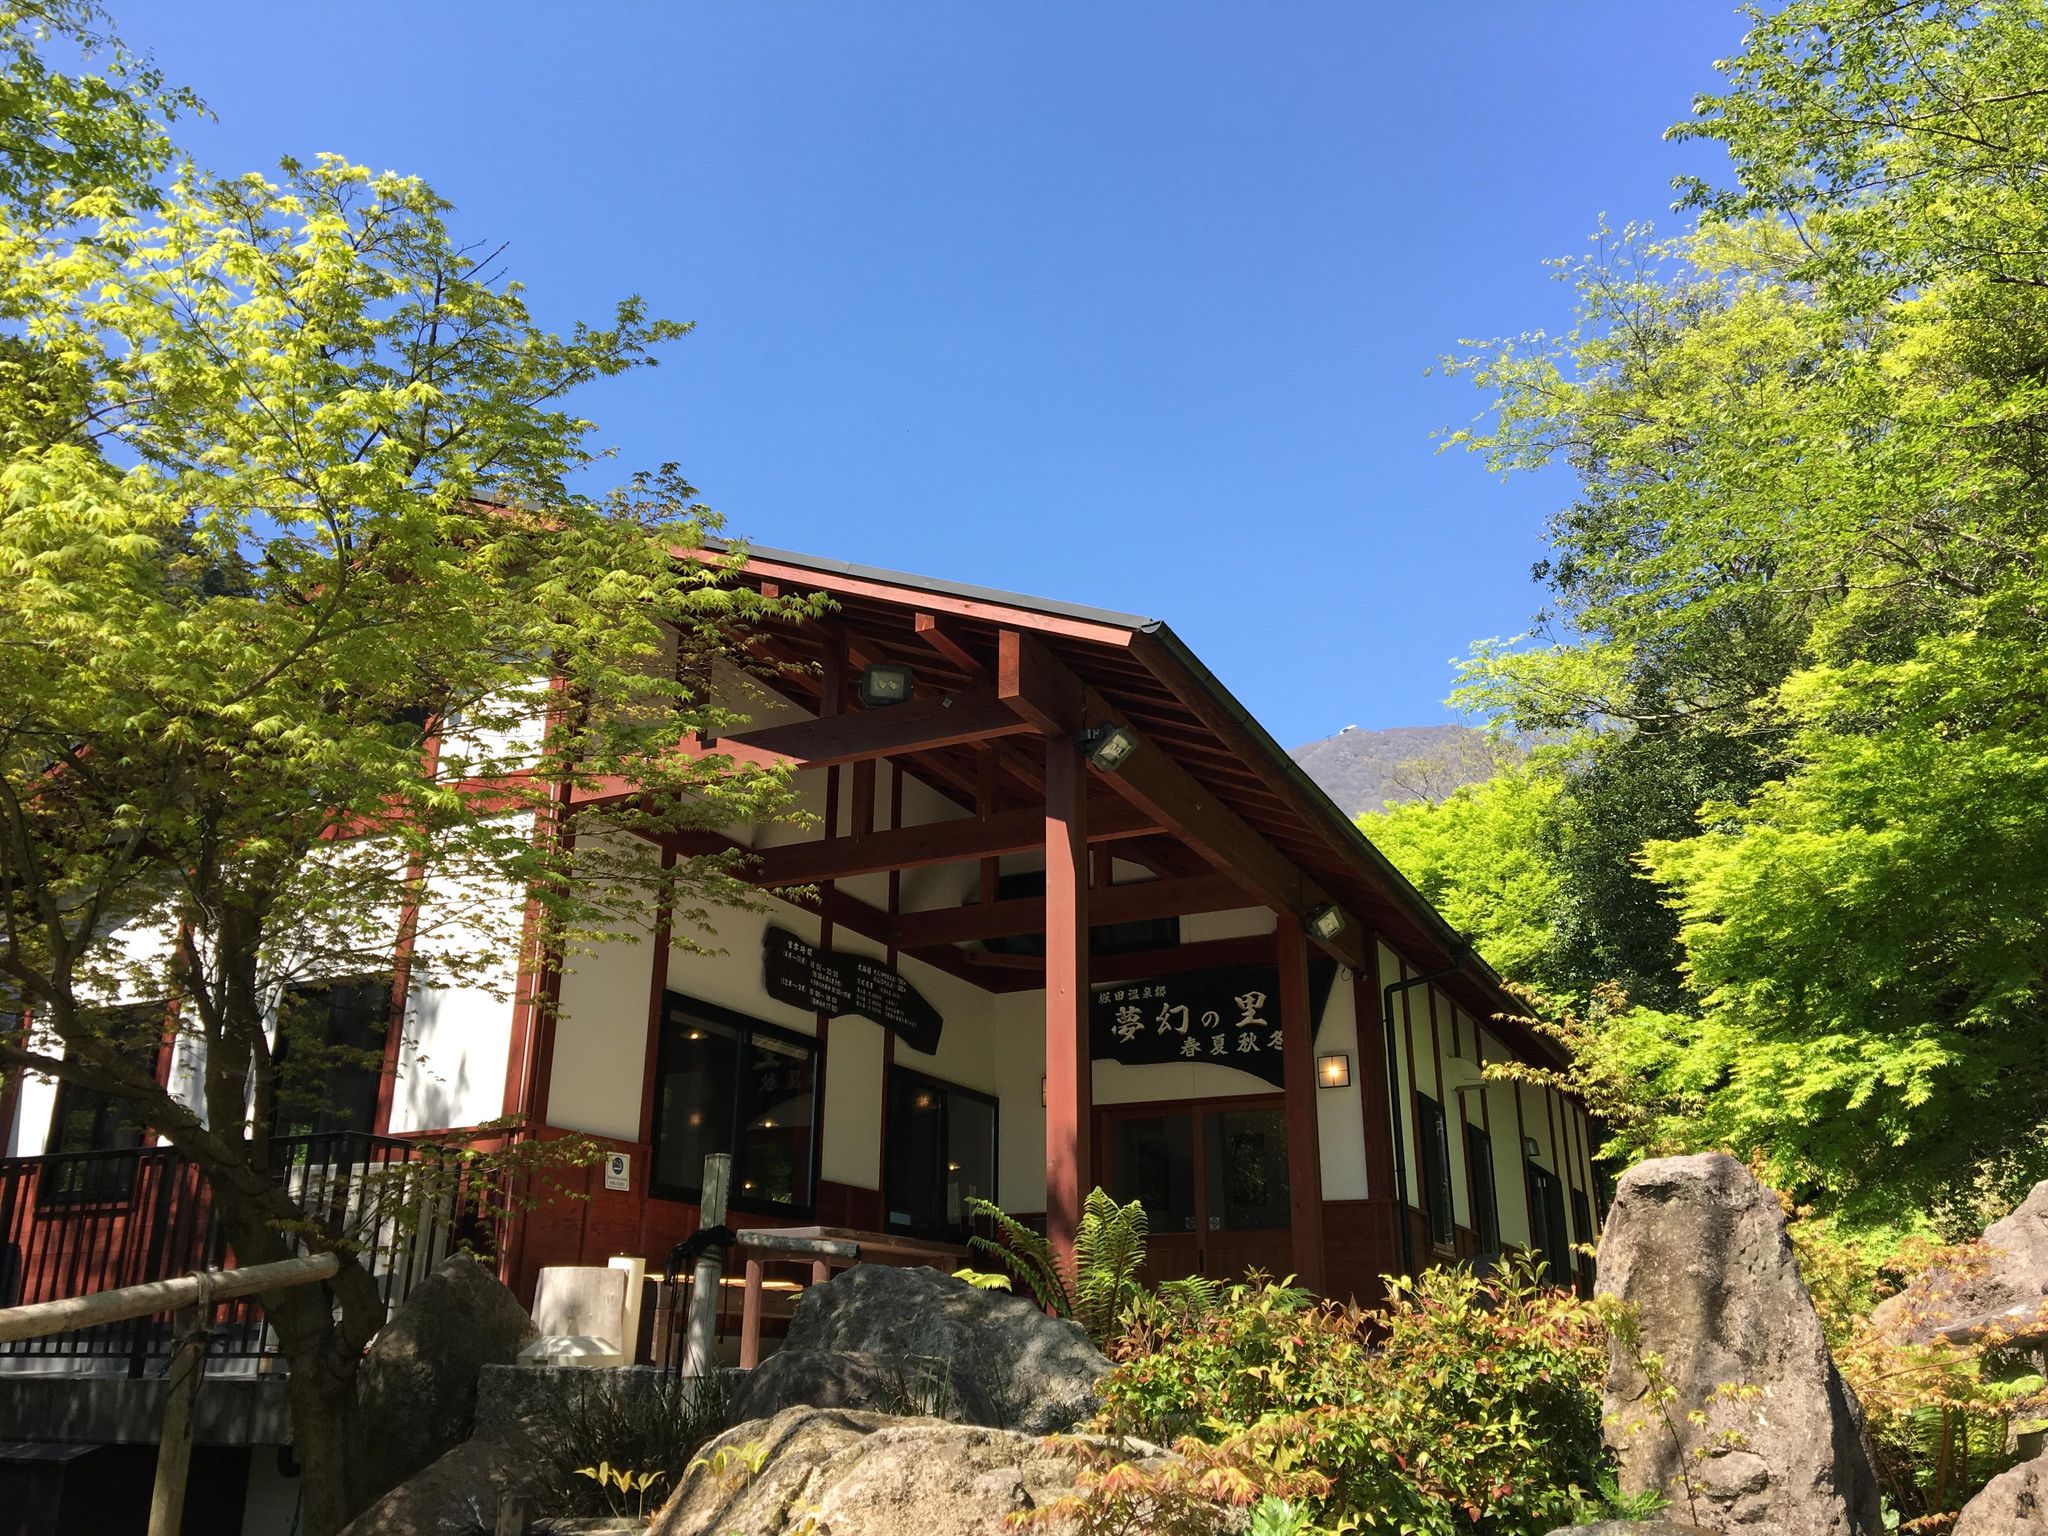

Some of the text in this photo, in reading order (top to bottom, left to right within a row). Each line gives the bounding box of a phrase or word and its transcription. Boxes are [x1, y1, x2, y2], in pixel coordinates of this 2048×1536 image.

[1098, 985, 1167, 1004] 堀田温泉郷
[1111, 991, 1268, 1044] 夢幻の里
[1180, 1030, 1283, 1057] 春夏秋冬
